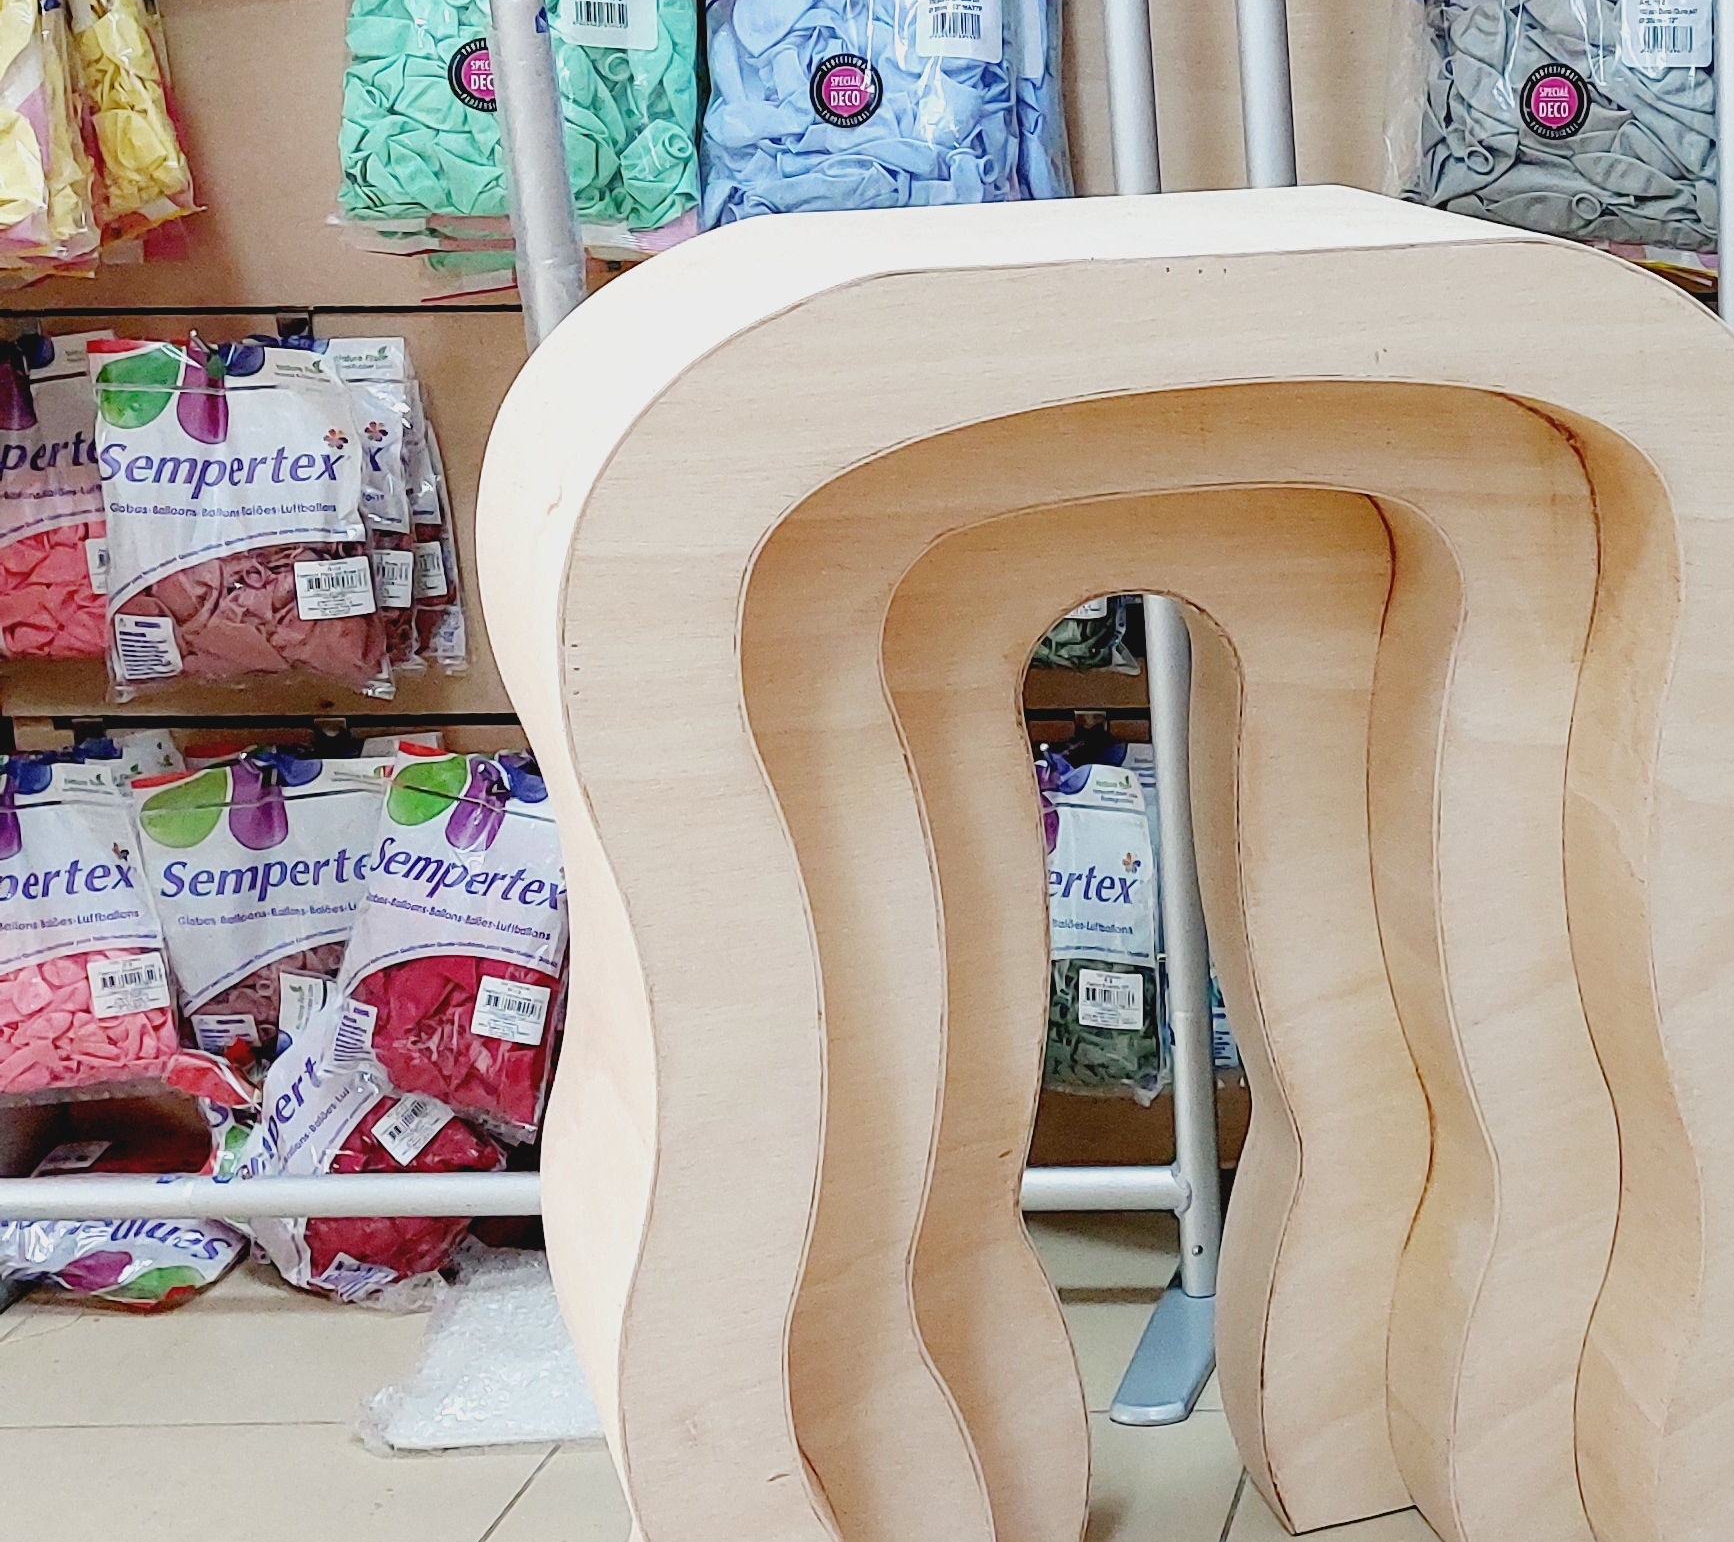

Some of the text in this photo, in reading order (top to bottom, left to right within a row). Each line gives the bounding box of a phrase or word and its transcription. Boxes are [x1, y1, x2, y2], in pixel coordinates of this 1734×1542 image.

[470, 60, 490, 71] SPEC
[470, 75, 494, 92] DEC
[1539, 86, 1569, 97] SPECIAL
[829, 90, 861, 106] DECO
[1538, 102, 1569, 118] DECO
[99, 442, 346, 500] Sempertex
[370, 837, 567, 911] Sempertex
